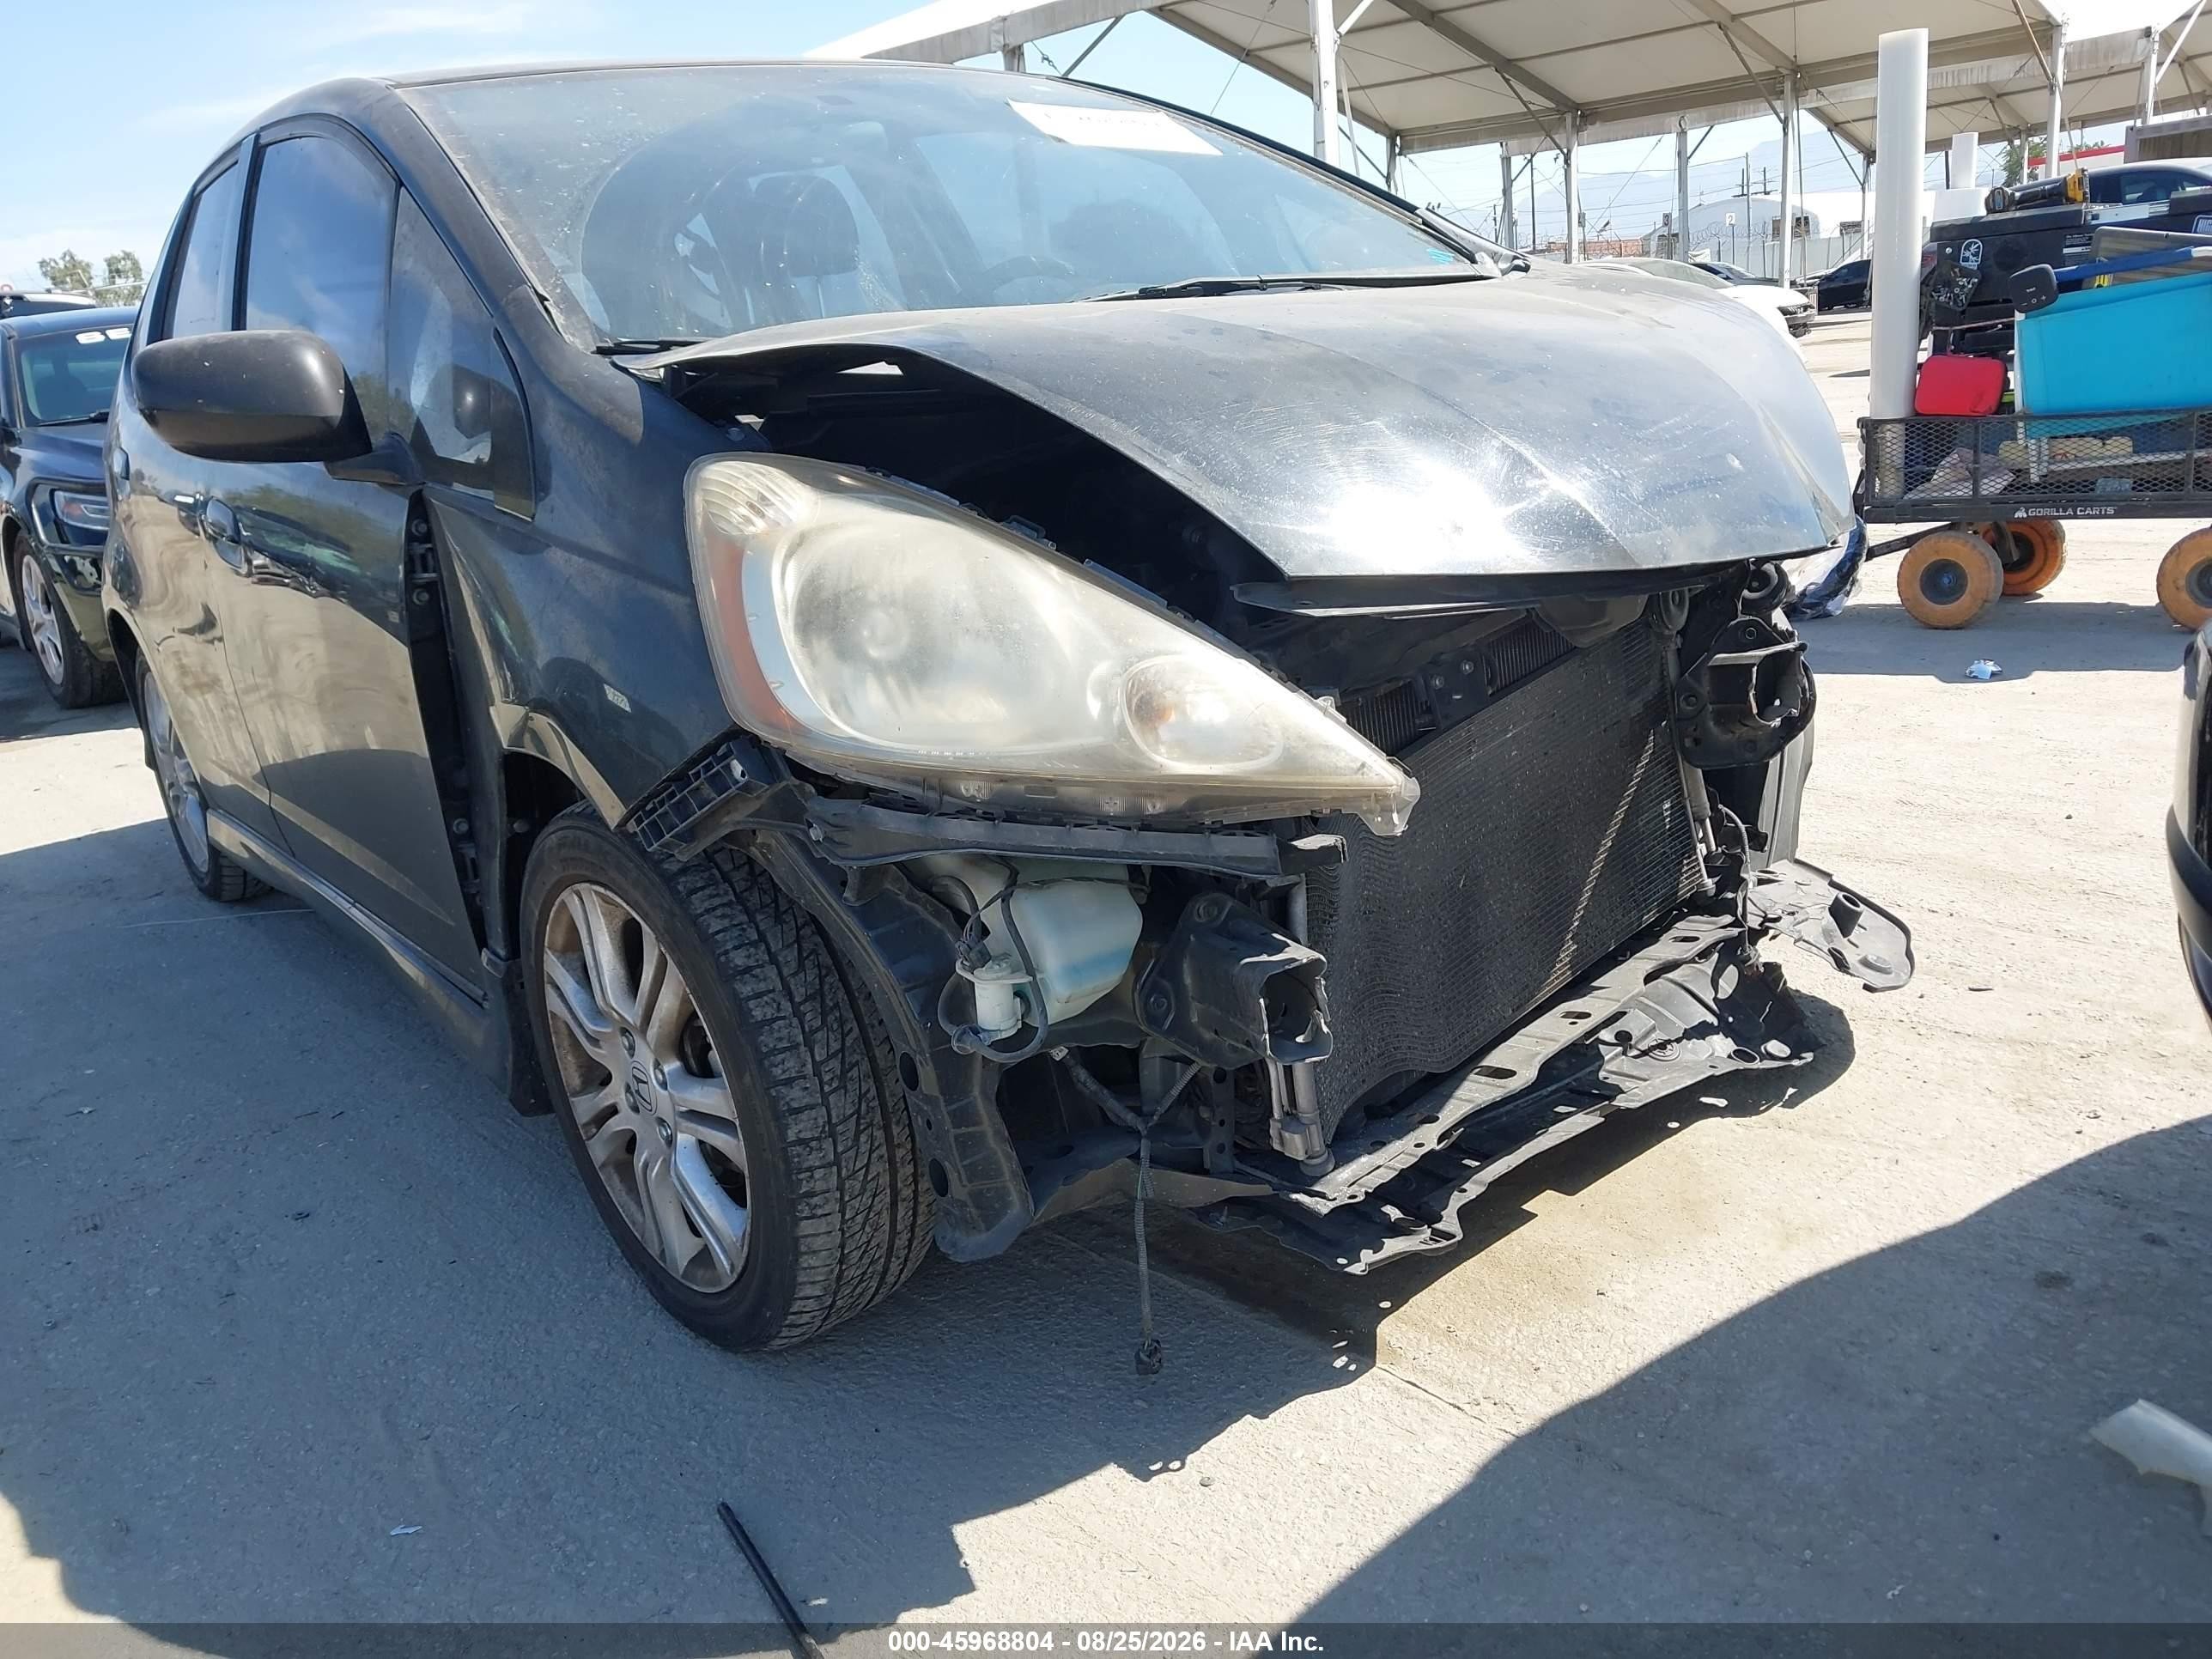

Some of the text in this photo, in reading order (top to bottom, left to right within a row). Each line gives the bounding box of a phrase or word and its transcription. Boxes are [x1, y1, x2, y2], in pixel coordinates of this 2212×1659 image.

[1664, 214, 1669, 227] 3
[1728, 215, 1734, 226] 2
[2028, 507, 2114, 516] GORILLA CARTS
